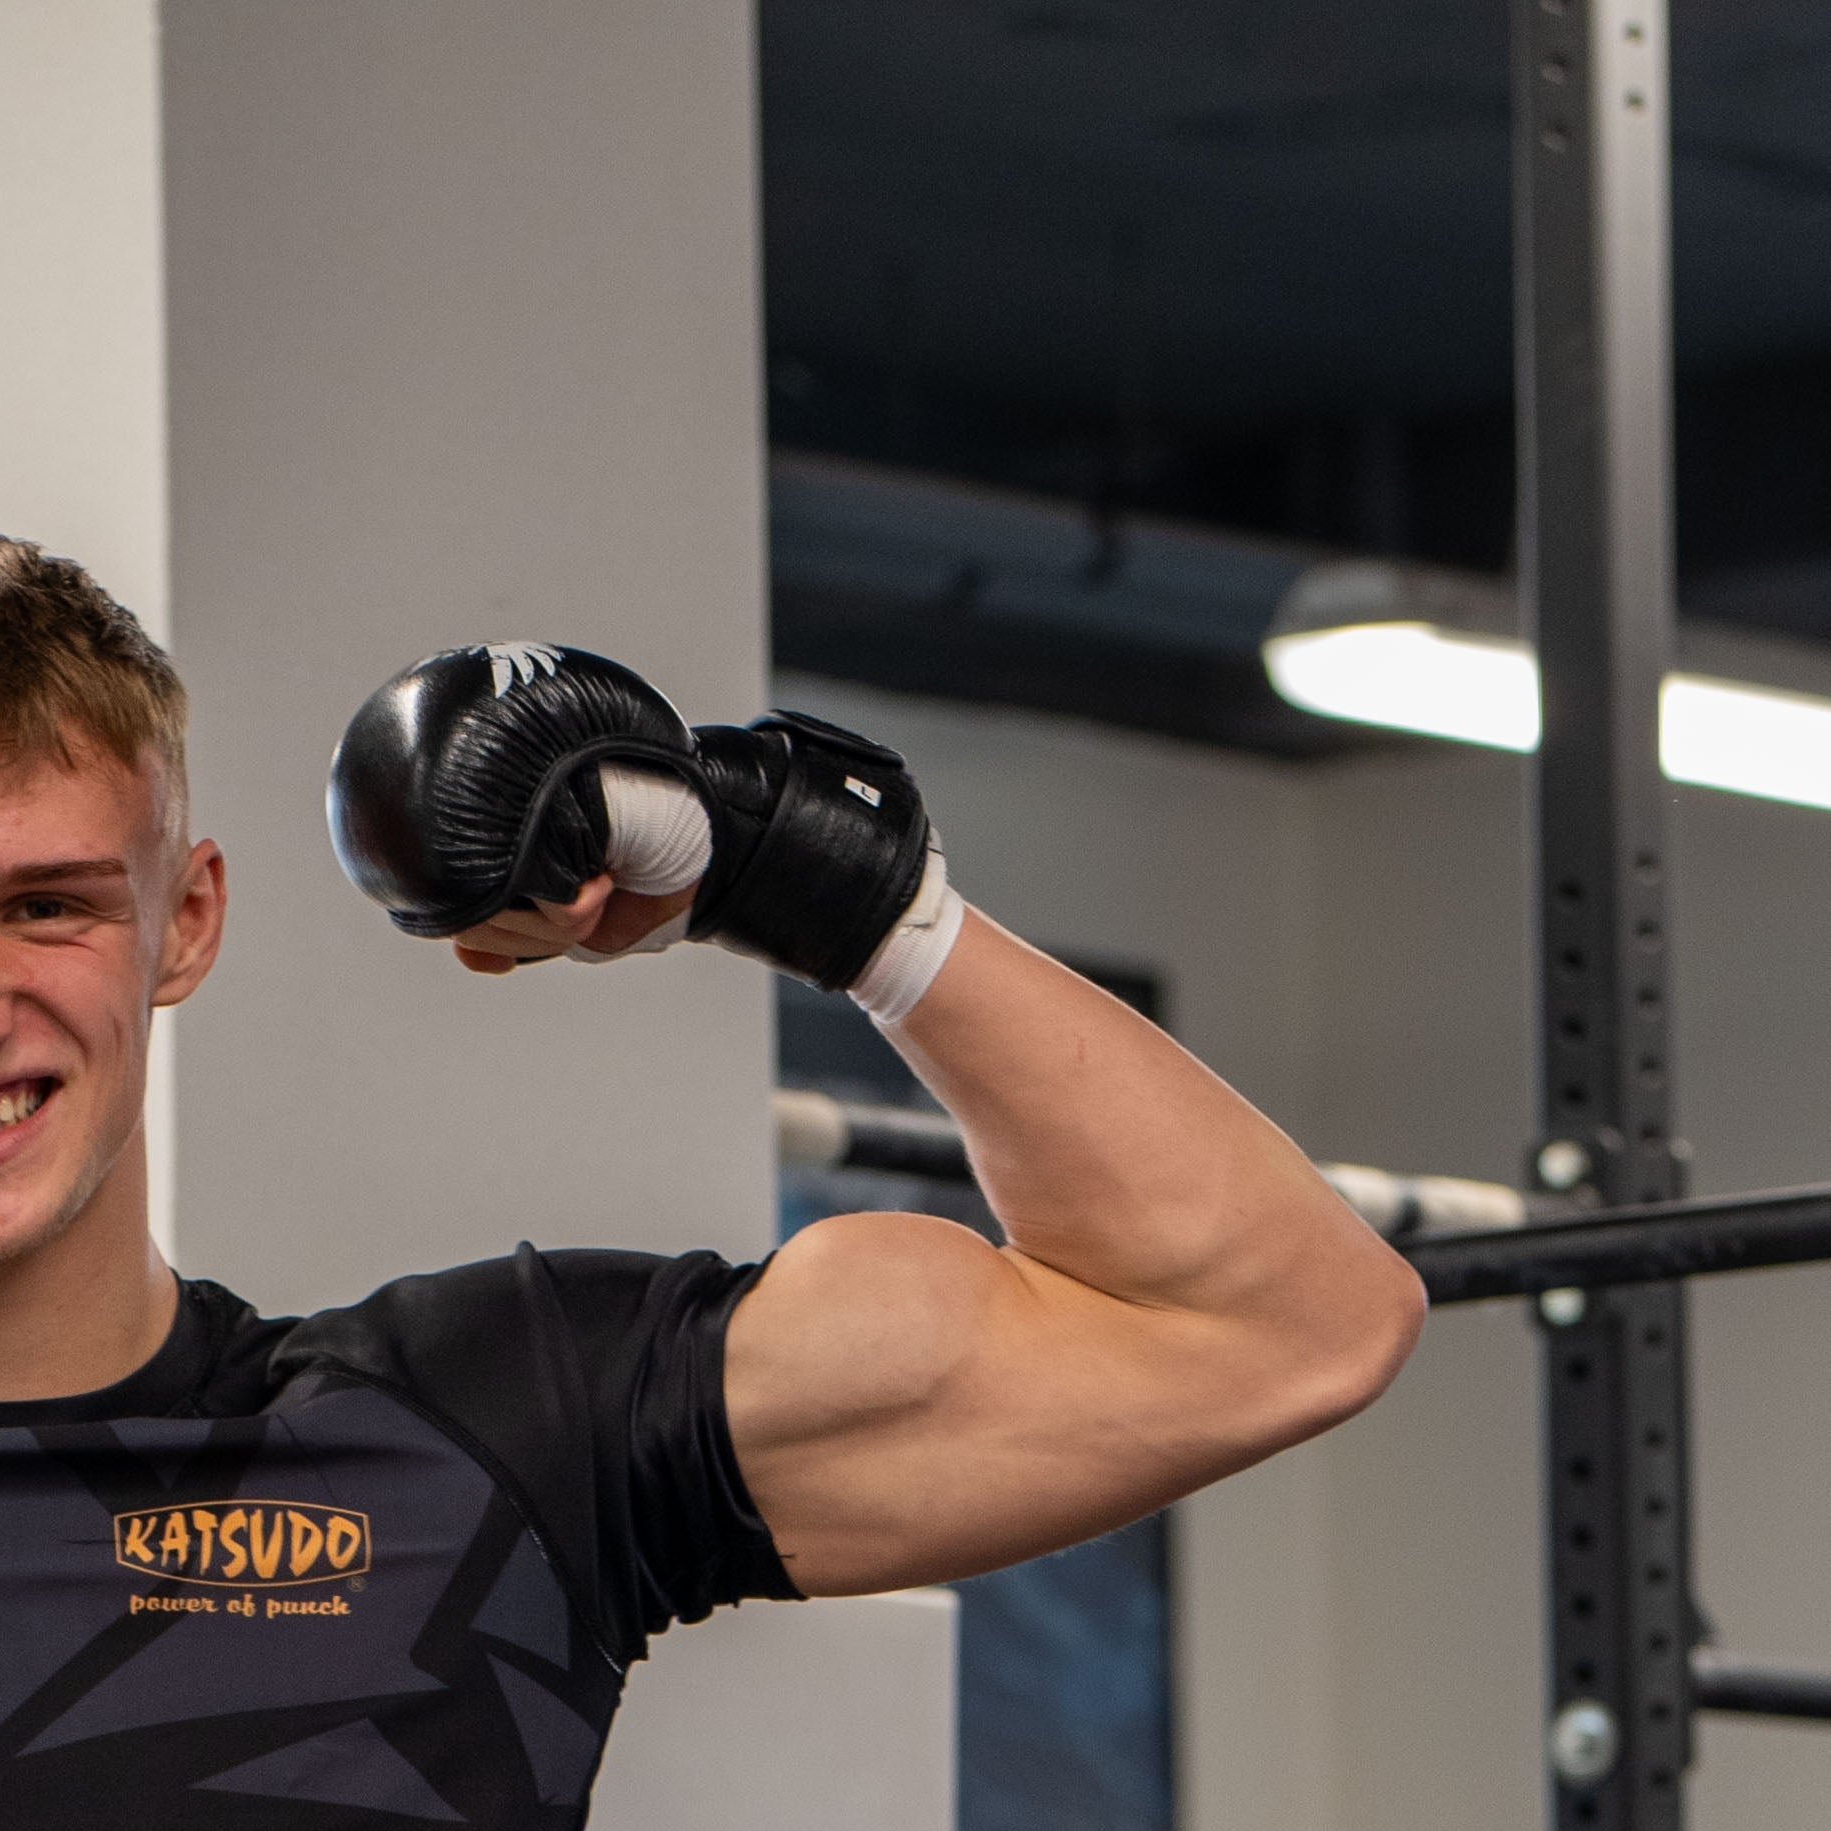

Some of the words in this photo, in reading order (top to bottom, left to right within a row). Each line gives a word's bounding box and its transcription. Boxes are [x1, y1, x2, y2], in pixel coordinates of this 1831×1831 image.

[125, 1508, 361, 1578] KATSUDO
[130, 1594, 218, 1615] power
[226, 1594, 256, 1617] of
[266, 1596, 350, 1618] punch
